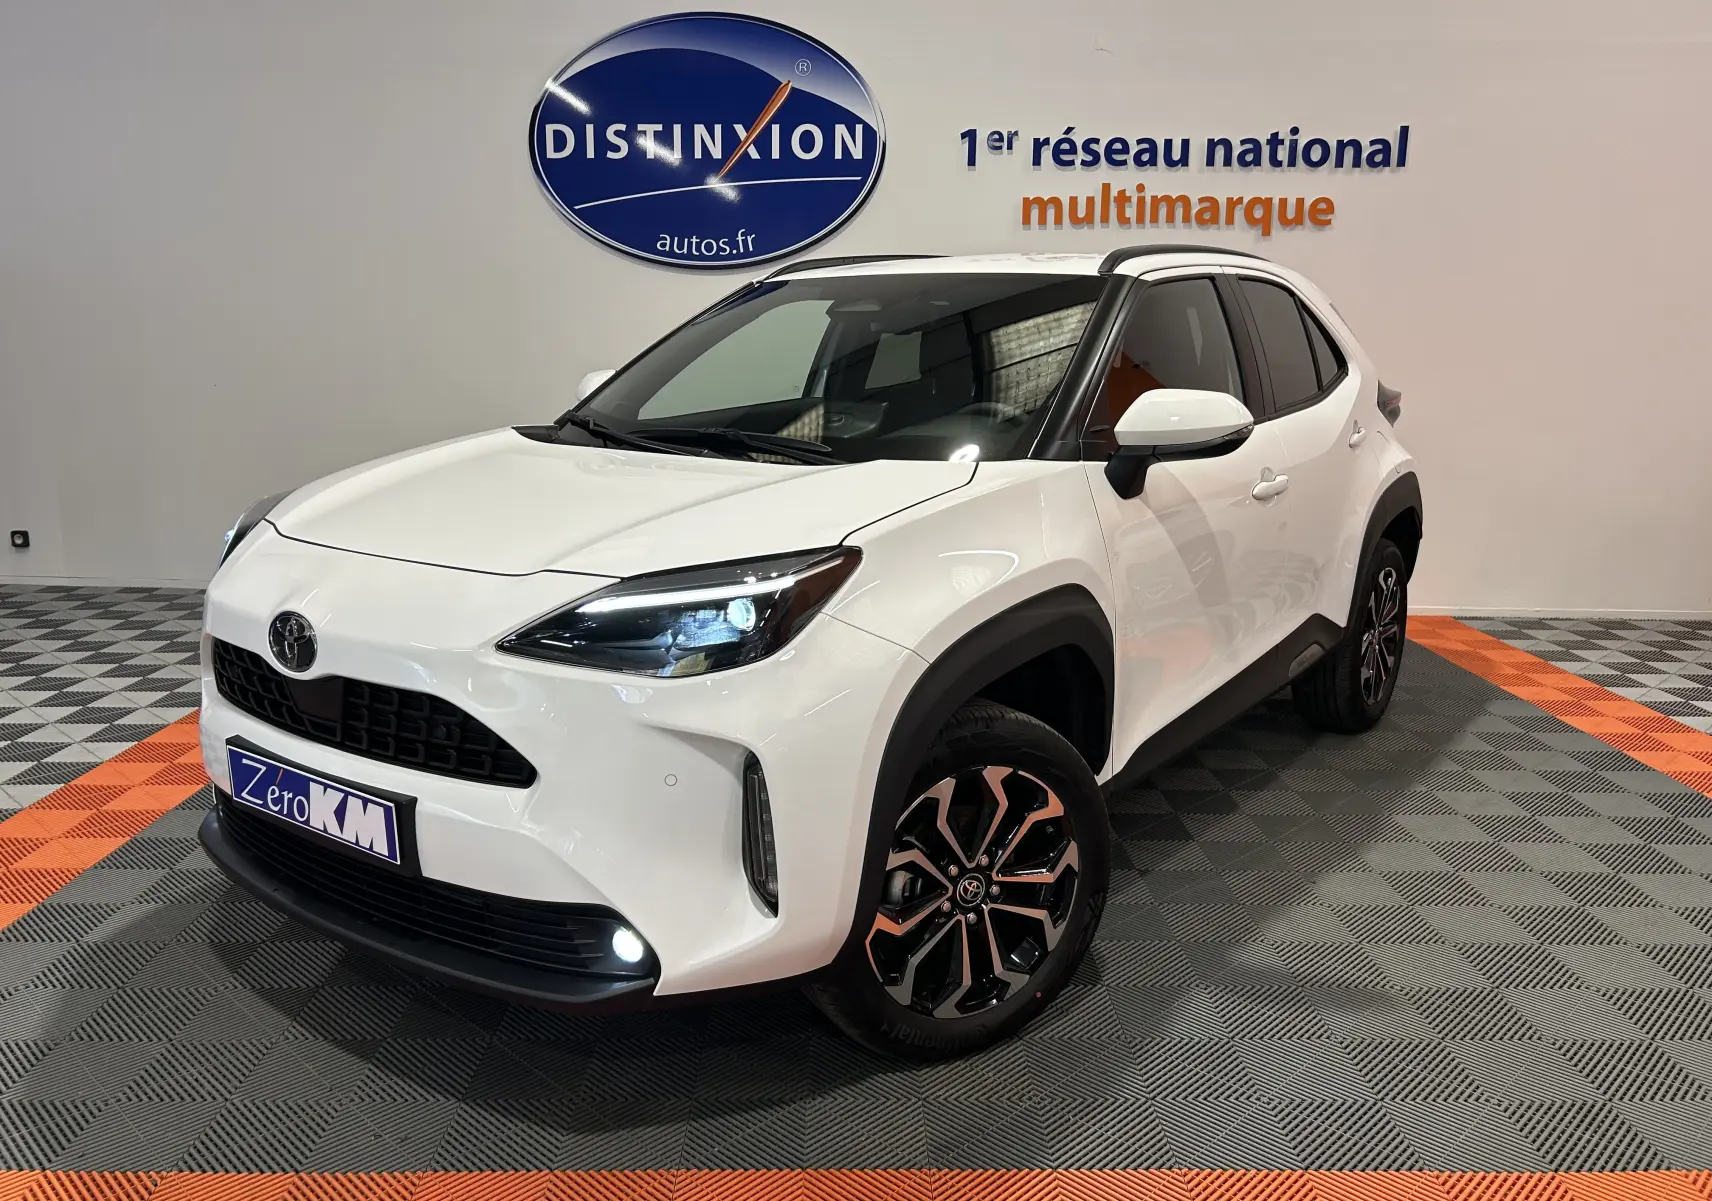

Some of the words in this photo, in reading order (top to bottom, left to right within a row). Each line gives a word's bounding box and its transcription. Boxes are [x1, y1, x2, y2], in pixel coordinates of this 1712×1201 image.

[545, 123, 864, 161] DISTINXION
[959, 127, 1019, 167] 1er
[1031, 126, 1190, 168] réseau
[1205, 125, 1410, 169] national
[1021, 182, 1335, 237] multimarque
[656, 228, 756, 257] autos.fr
